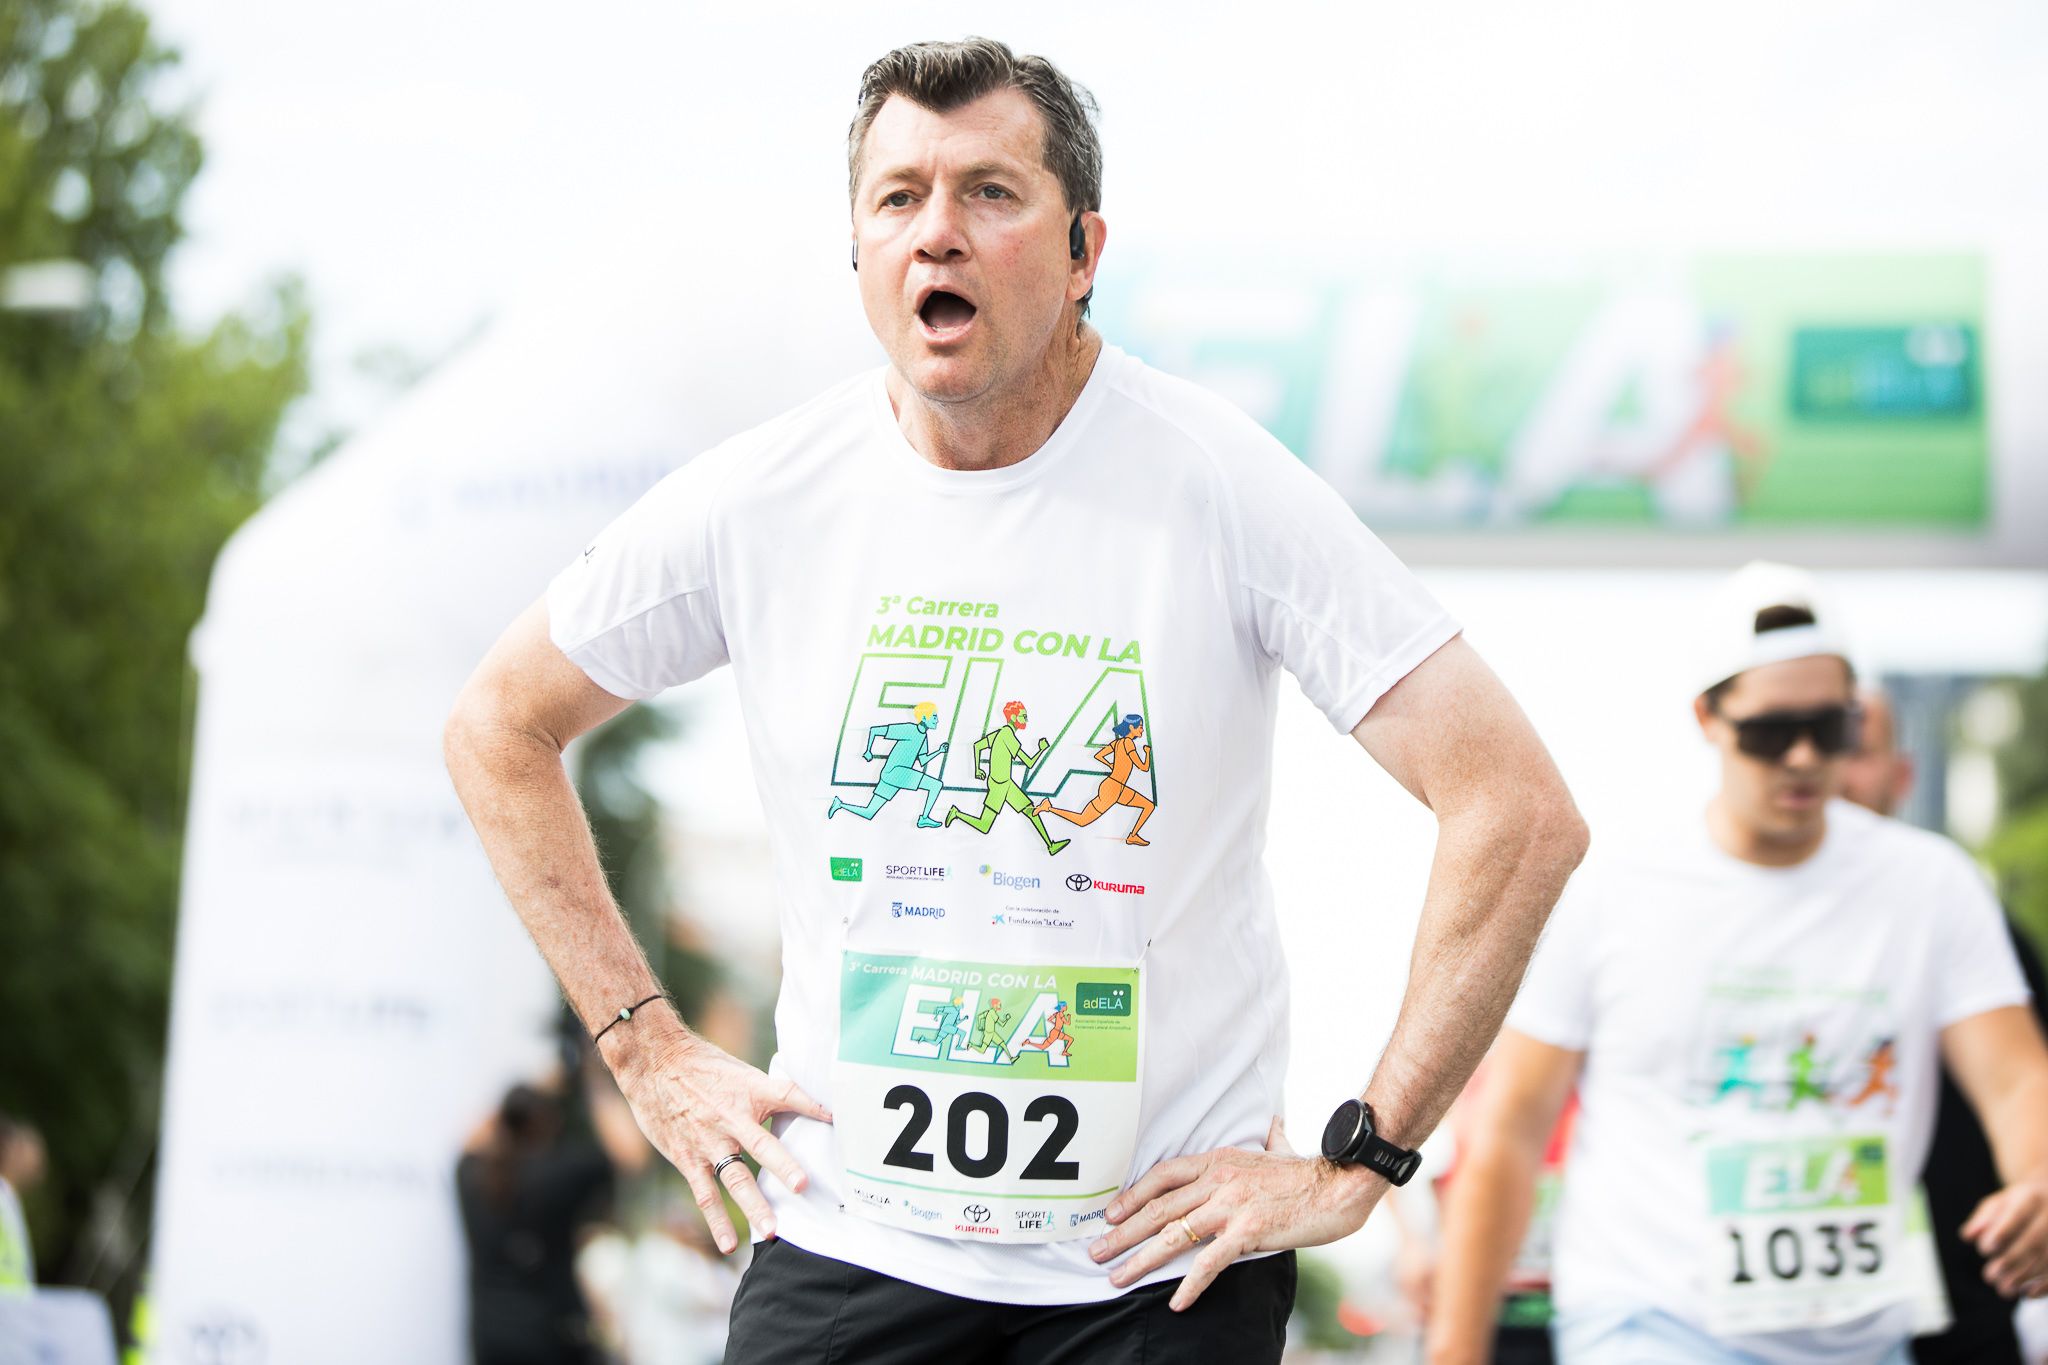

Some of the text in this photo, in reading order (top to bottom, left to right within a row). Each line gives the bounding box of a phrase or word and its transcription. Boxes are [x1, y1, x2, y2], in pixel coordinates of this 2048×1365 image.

[876, 595, 999, 618] 3ª Carrera
[866, 624, 1142, 664] MADRID CON LA
[831, 653, 1158, 807] ELA
[993, 871, 1041, 891] Biogen
[904, 906, 946, 919] MADRID
[1008, 915, 1043, 926] Fundación
[863, 963, 908, 976] Carrera
[911, 965, 983, 986] MADRID
[988, 972, 1030, 989] CON
[1033, 974, 1058, 990] LA
[890, 983, 1071, 1068] ELA
[883, 1084, 1080, 1181] 202
[1015, 1210, 1047, 1220] SPORT
[1018, 1220, 1043, 1229] LIFE
[1728, 1222, 1883, 1285] 1035
